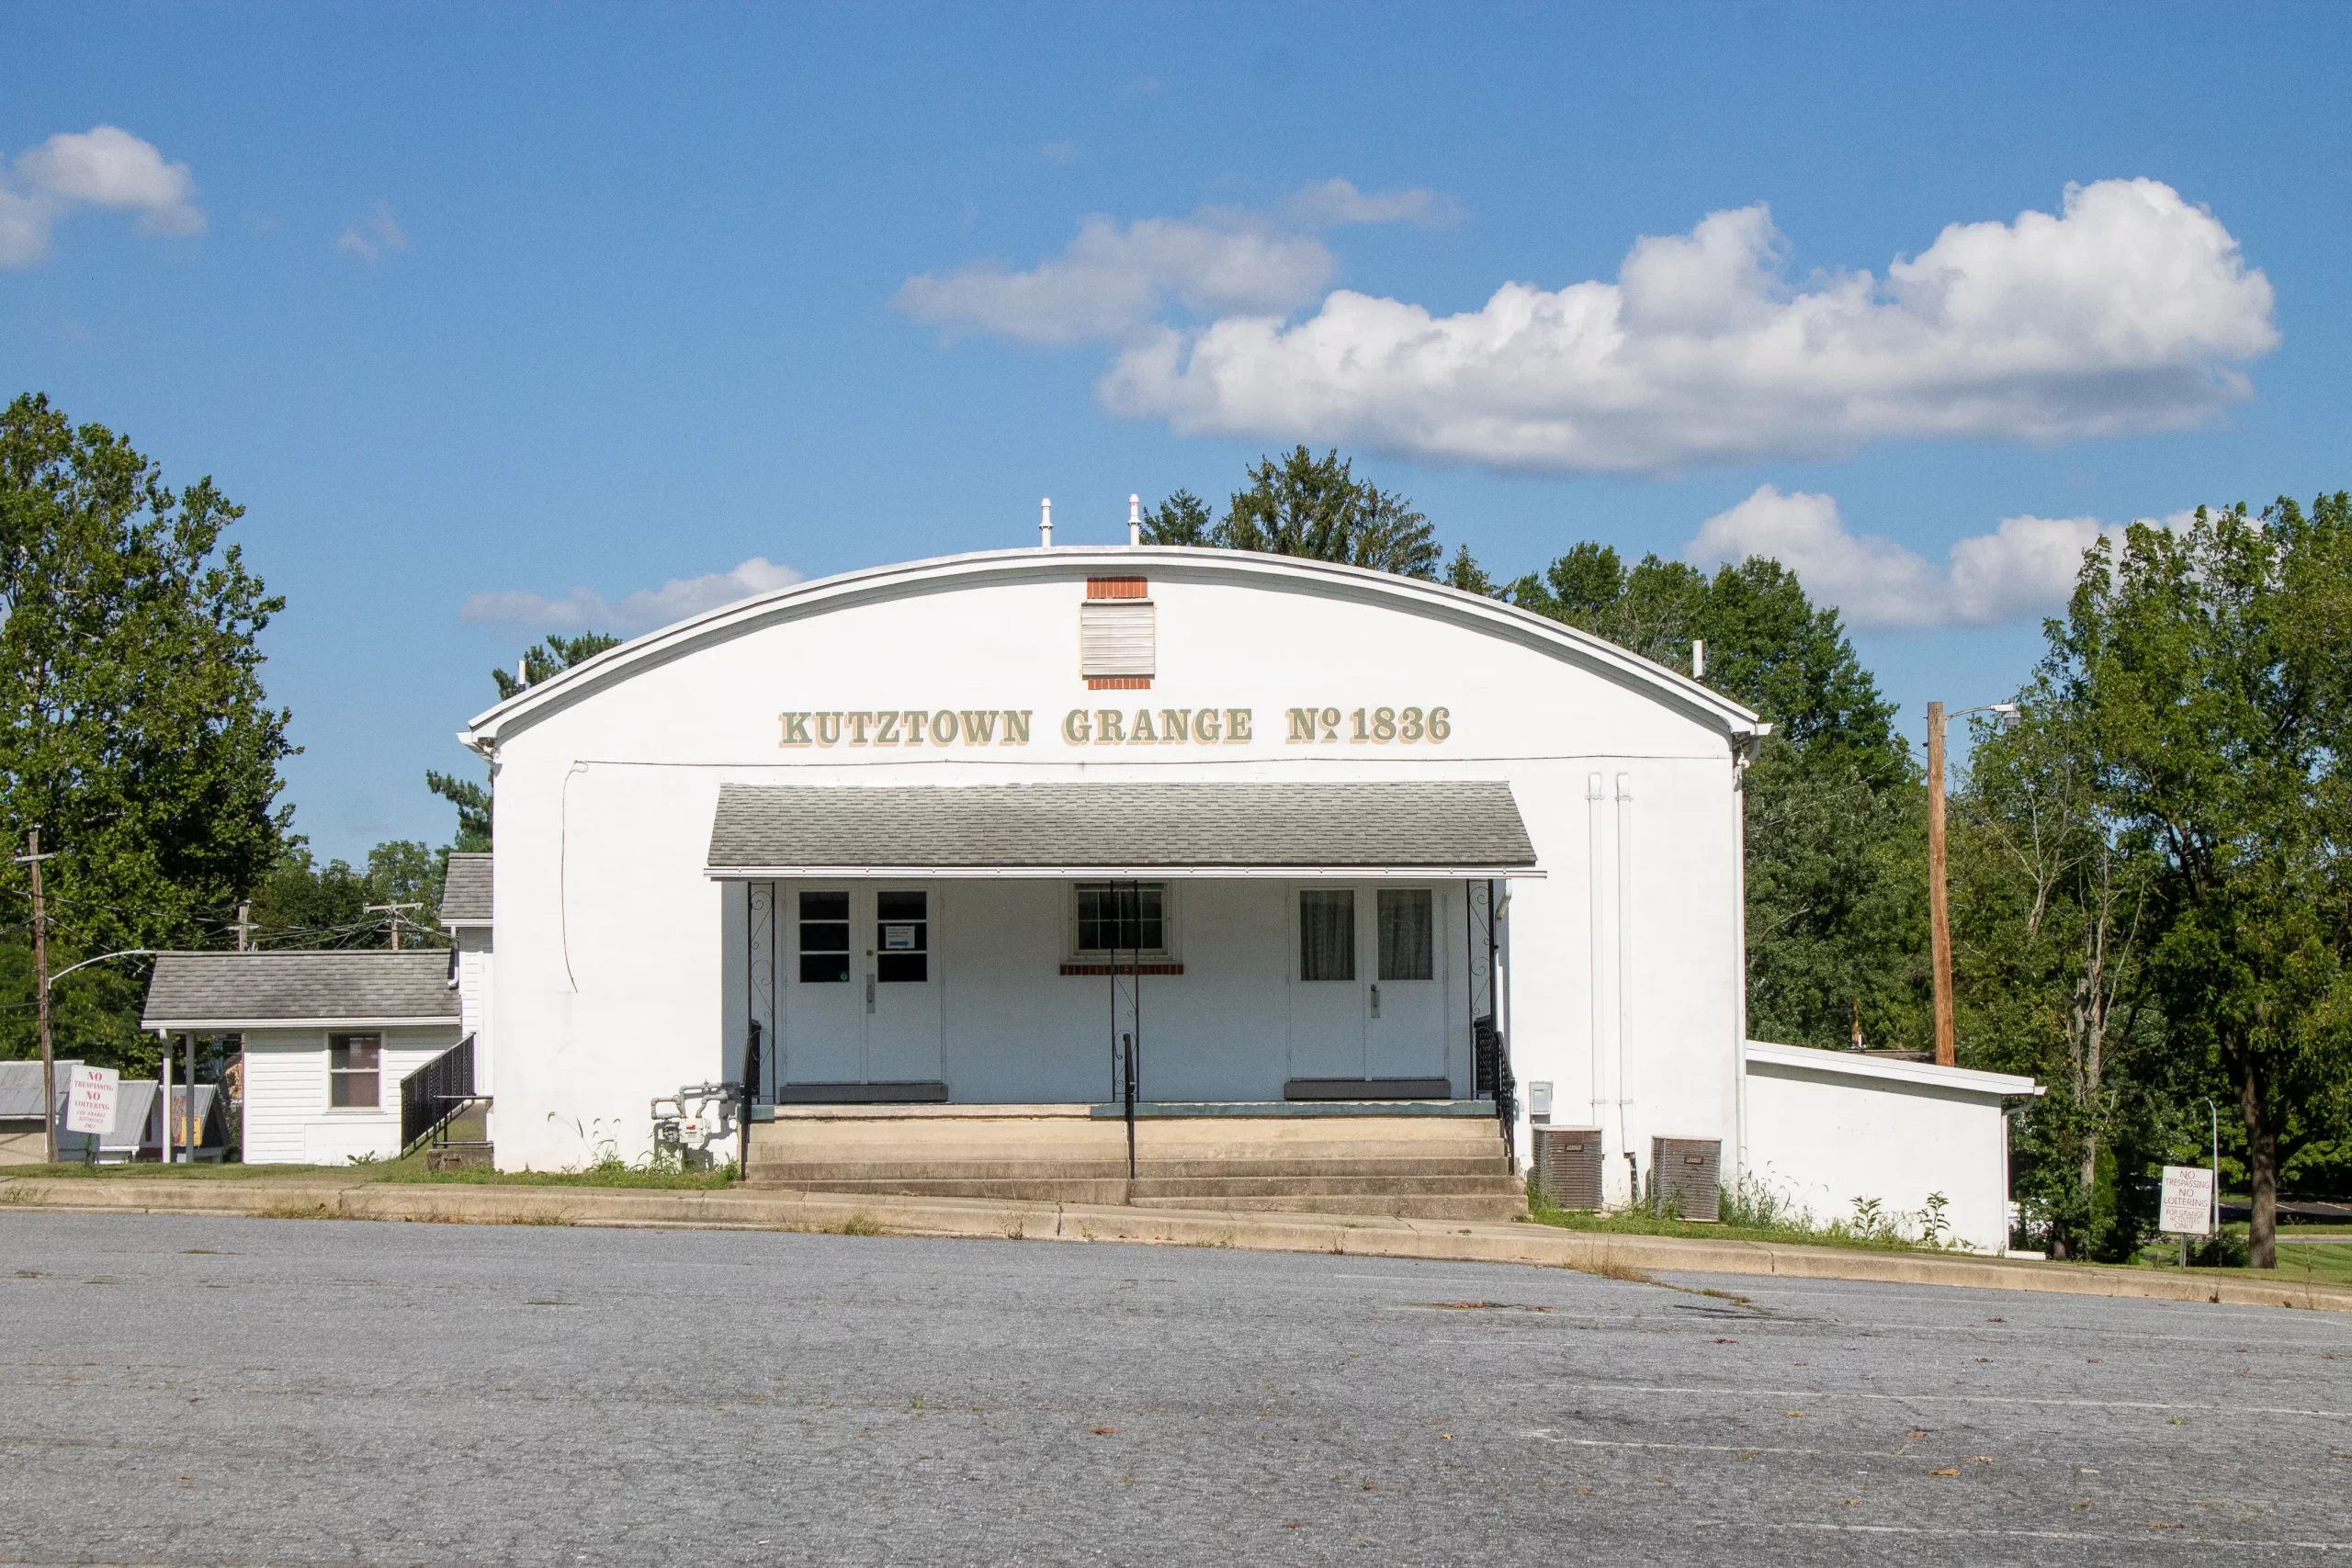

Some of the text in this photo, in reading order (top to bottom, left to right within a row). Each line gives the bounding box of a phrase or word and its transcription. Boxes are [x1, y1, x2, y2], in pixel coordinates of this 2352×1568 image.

[778, 710, 1033, 749] KUTZTOWN
[1061, 708, 1252, 746] GRANGE
[1349, 706, 1451, 745] 1836
[88, 1071, 102, 1081] NO
[74, 1080, 114, 1091] TRESPASSING
[86, 1090, 100, 1100] NO
[74, 1100, 109, 1110] LOITERING
[2179, 1170, 2195, 1179] NO
[2165, 1179, 2209, 1189] TRESPASSING
[2178, 1189, 2194, 1197] NO
[2164, 1197, 2208, 1207] LOITERING
